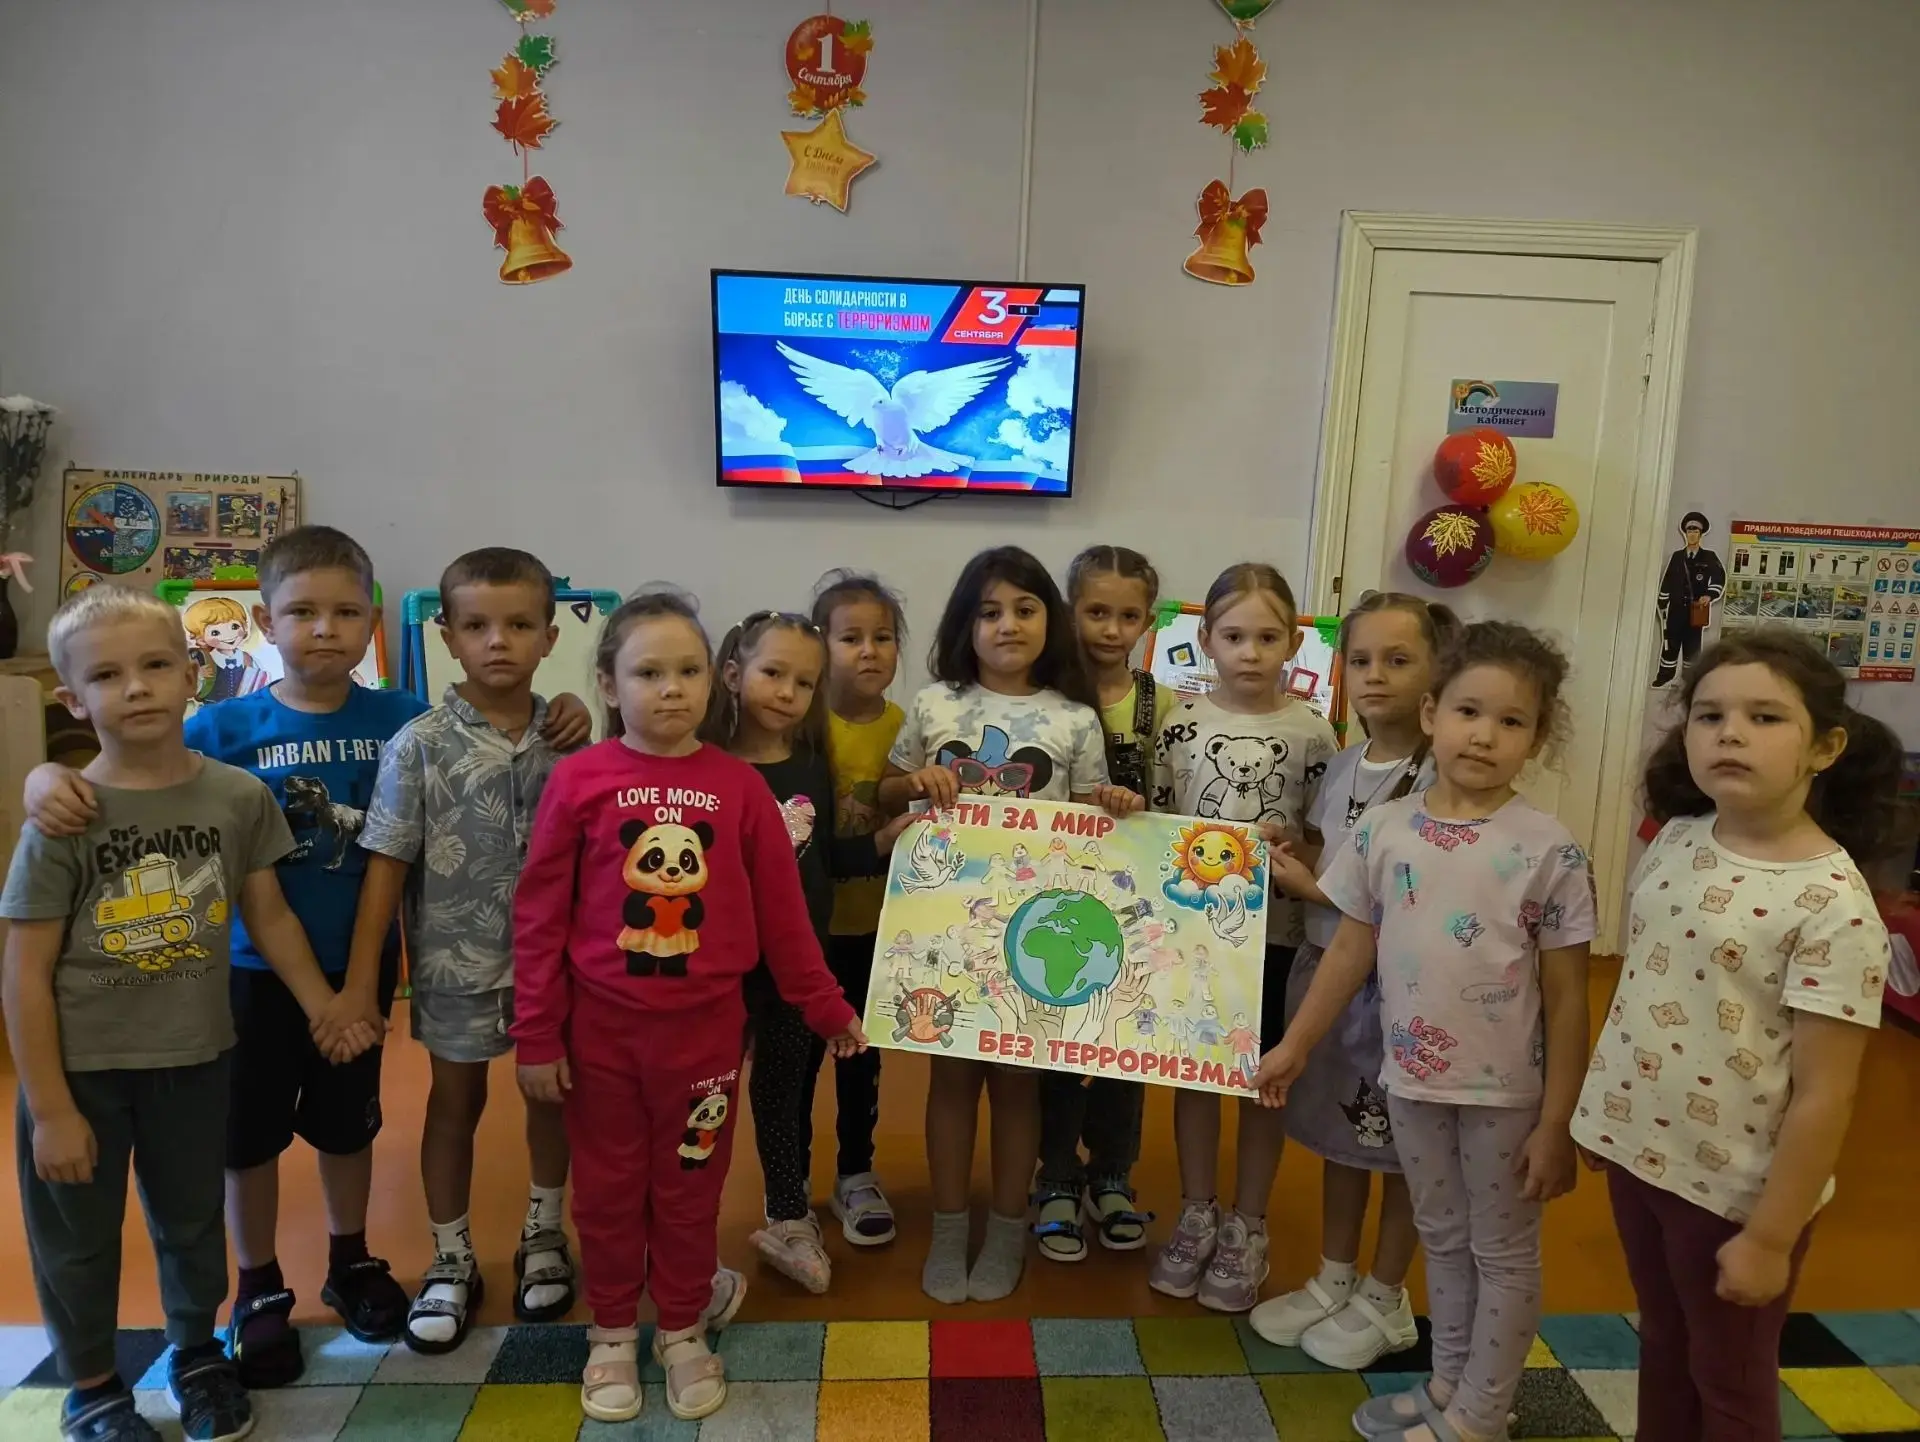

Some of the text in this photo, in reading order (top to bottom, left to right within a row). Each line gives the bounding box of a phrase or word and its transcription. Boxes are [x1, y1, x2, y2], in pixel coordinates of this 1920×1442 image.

[816, 33, 836, 73] 1
[798, 67, 852, 89] Сентября
[783, 287, 907, 308] ДЕНЬ СОЛИДАРНОСТИ В
[977, 290, 1007, 325] 3
[783, 311, 931, 333] БОРЬБЕ С ТЕРРОРИЗМОМ
[953, 329, 1004, 340] СЕНТЯБРЯ
[1459, 405, 1546, 417] методический
[1476, 415, 1528, 426] кабинет
[103, 470, 260, 484] КАЛЕНДАРЬ ПРИРОДЫ
[1744, 524, 1920, 541] ПРАВИЛА ПОВЕДЕНИЯ ПЕШЕХОДА НА ДОРОГ
[256, 740, 332, 770] URBAN
[617, 787, 721, 812] LOVE MODE:
[654, 806, 682, 824] ON
[1001, 807, 1039, 831] ЗА
[1051, 811, 1115, 838] МИР
[95, 825, 222, 874] EXCAVATOR
[978, 1030, 1249, 1090] БЕЗ ТЕРРОРИЗМА
